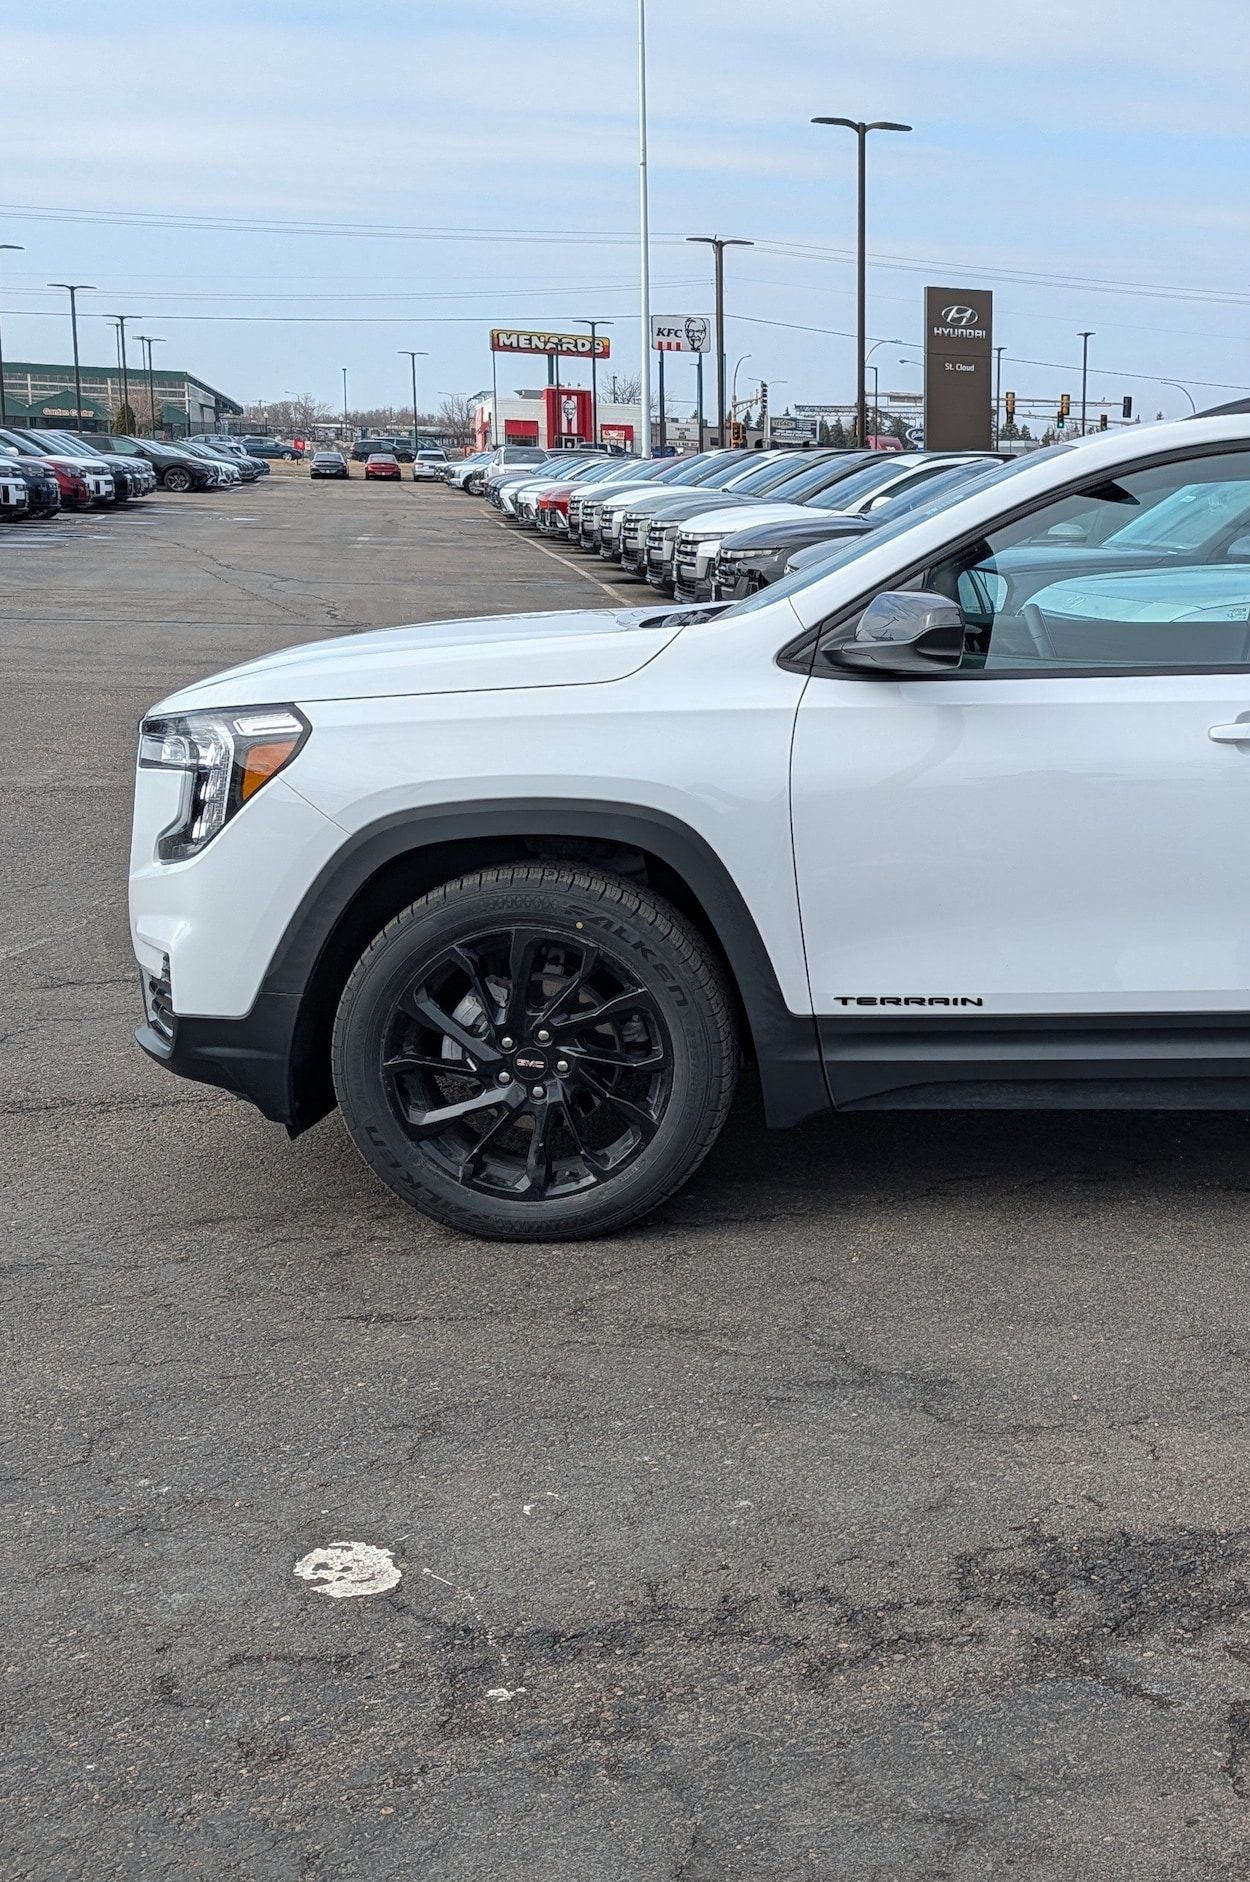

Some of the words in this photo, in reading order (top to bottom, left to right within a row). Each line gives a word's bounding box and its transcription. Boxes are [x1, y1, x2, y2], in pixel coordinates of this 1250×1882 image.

[656, 327, 683, 338] KFC
[933, 327, 986, 339] HYUNDAI
[498, 332, 604, 354] MENARDS
[955, 363, 975, 371] Cloud
[43, 408, 70, 416] Garden
[70, 409, 94, 417] Ceter
[833, 996, 984, 1007] TERRAIN
[516, 1058, 545, 1069] GMC
